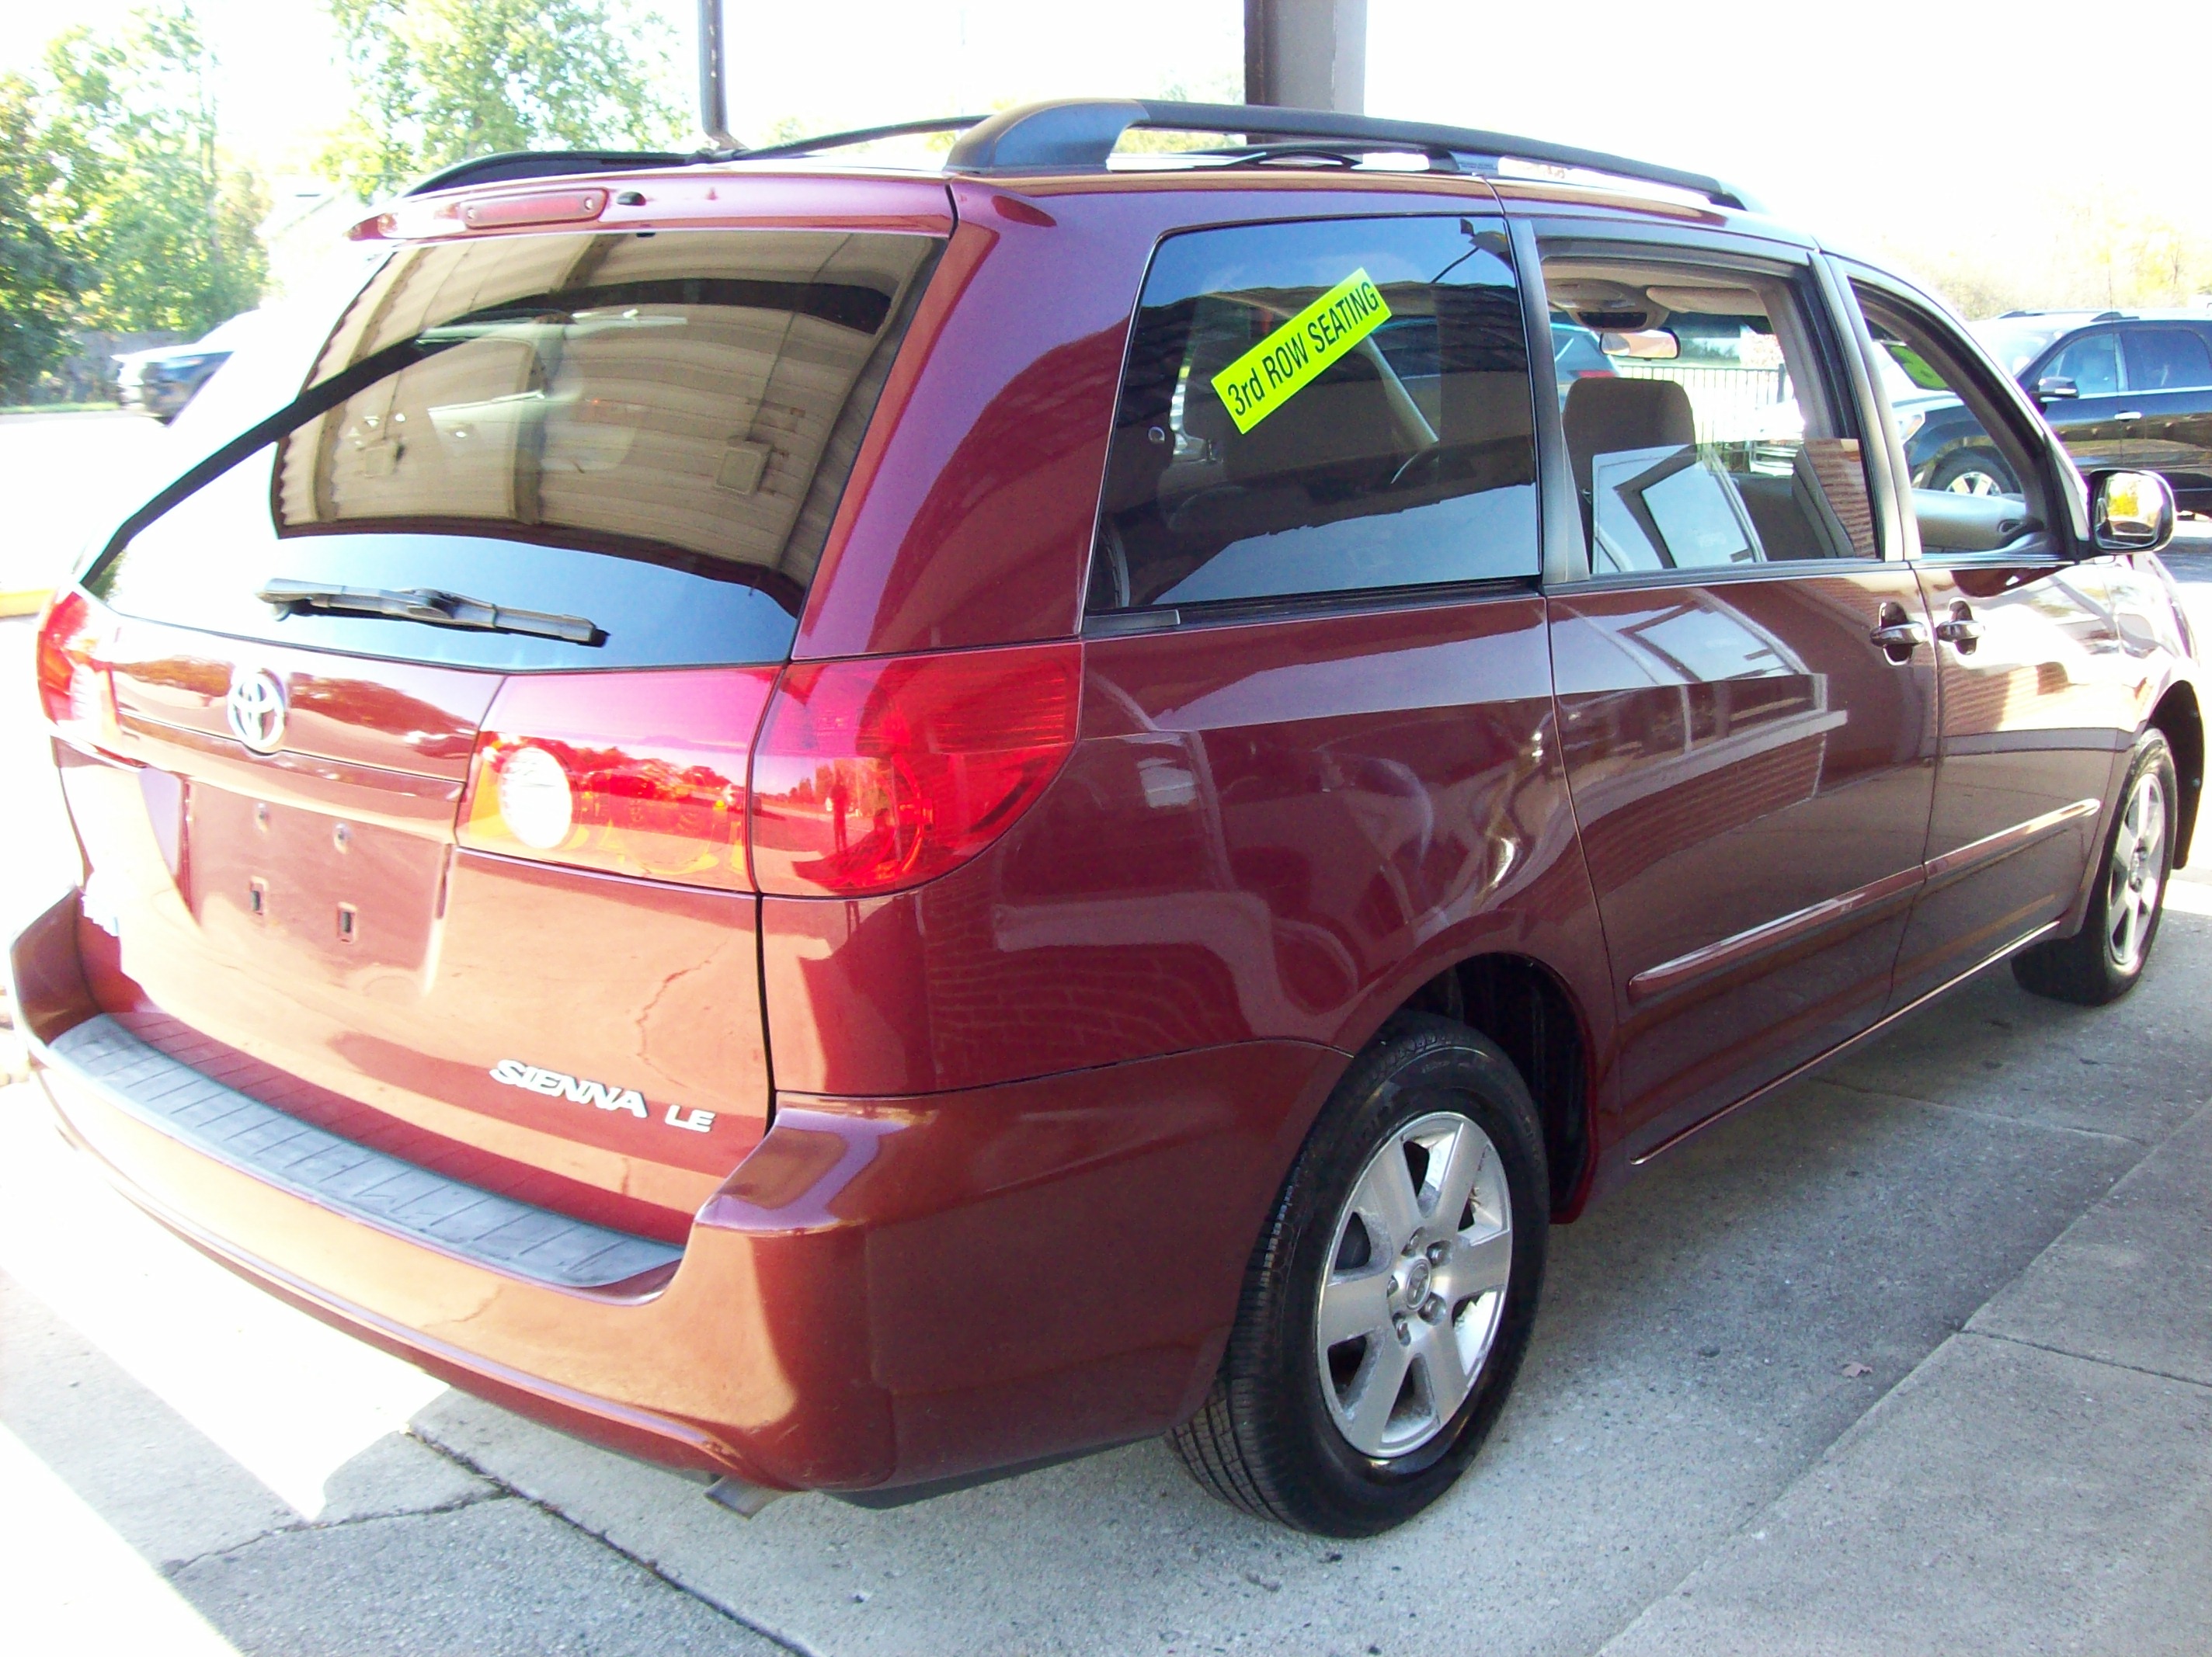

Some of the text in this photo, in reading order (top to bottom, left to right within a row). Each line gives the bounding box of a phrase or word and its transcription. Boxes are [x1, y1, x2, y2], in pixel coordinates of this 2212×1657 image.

[1227, 282, 1379, 416] 3rd ROW SEATING
[489, 1059, 715, 1133] SIENNA LE
